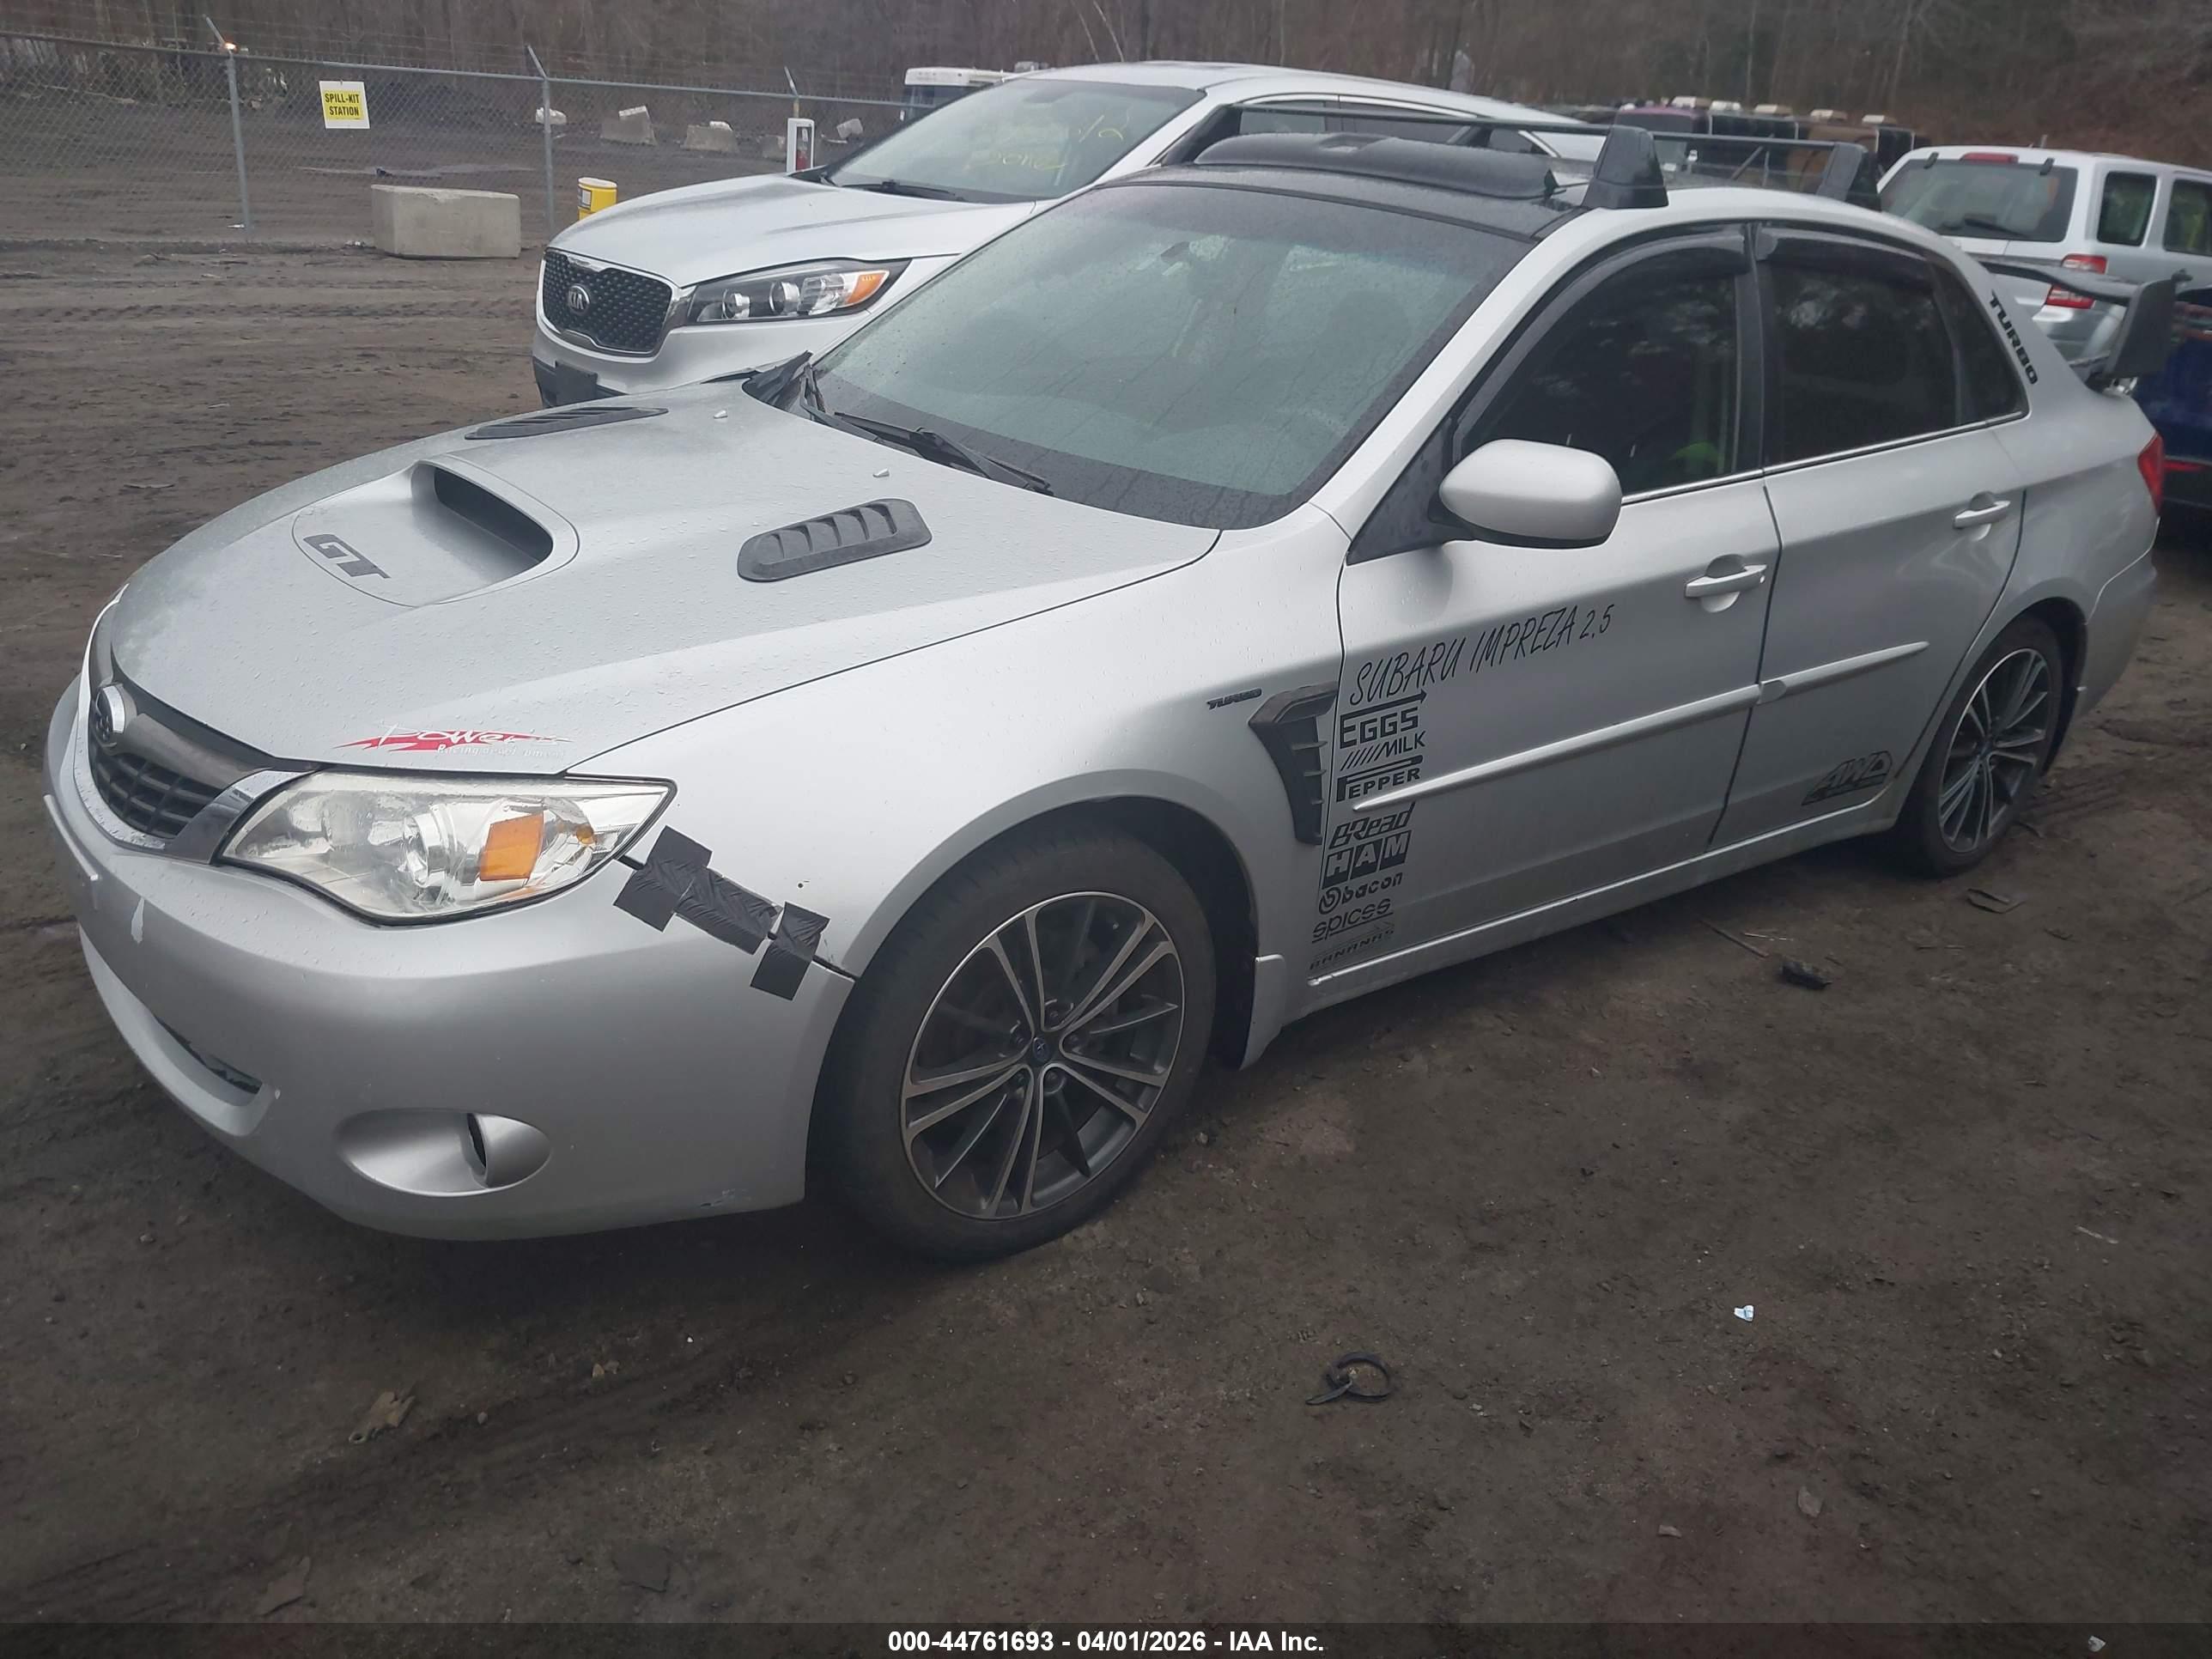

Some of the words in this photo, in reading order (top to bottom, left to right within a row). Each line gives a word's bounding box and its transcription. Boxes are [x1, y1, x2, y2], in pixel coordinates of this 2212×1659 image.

[325, 93, 360, 103] SPILL-KIT
[329, 106, 360, 116] STATION
[1990, 289, 2038, 385] TURBO
[303, 533, 392, 579] GT
[1350, 637, 1466, 705] SUBARU
[1469, 605, 1577, 673] IMPREZA
[1340, 700, 1421, 749] EGGS
[1336, 755, 1424, 803] PEPPER
[1810, 750, 1893, 795] AWD
[1323, 831, 1411, 885] HAM
